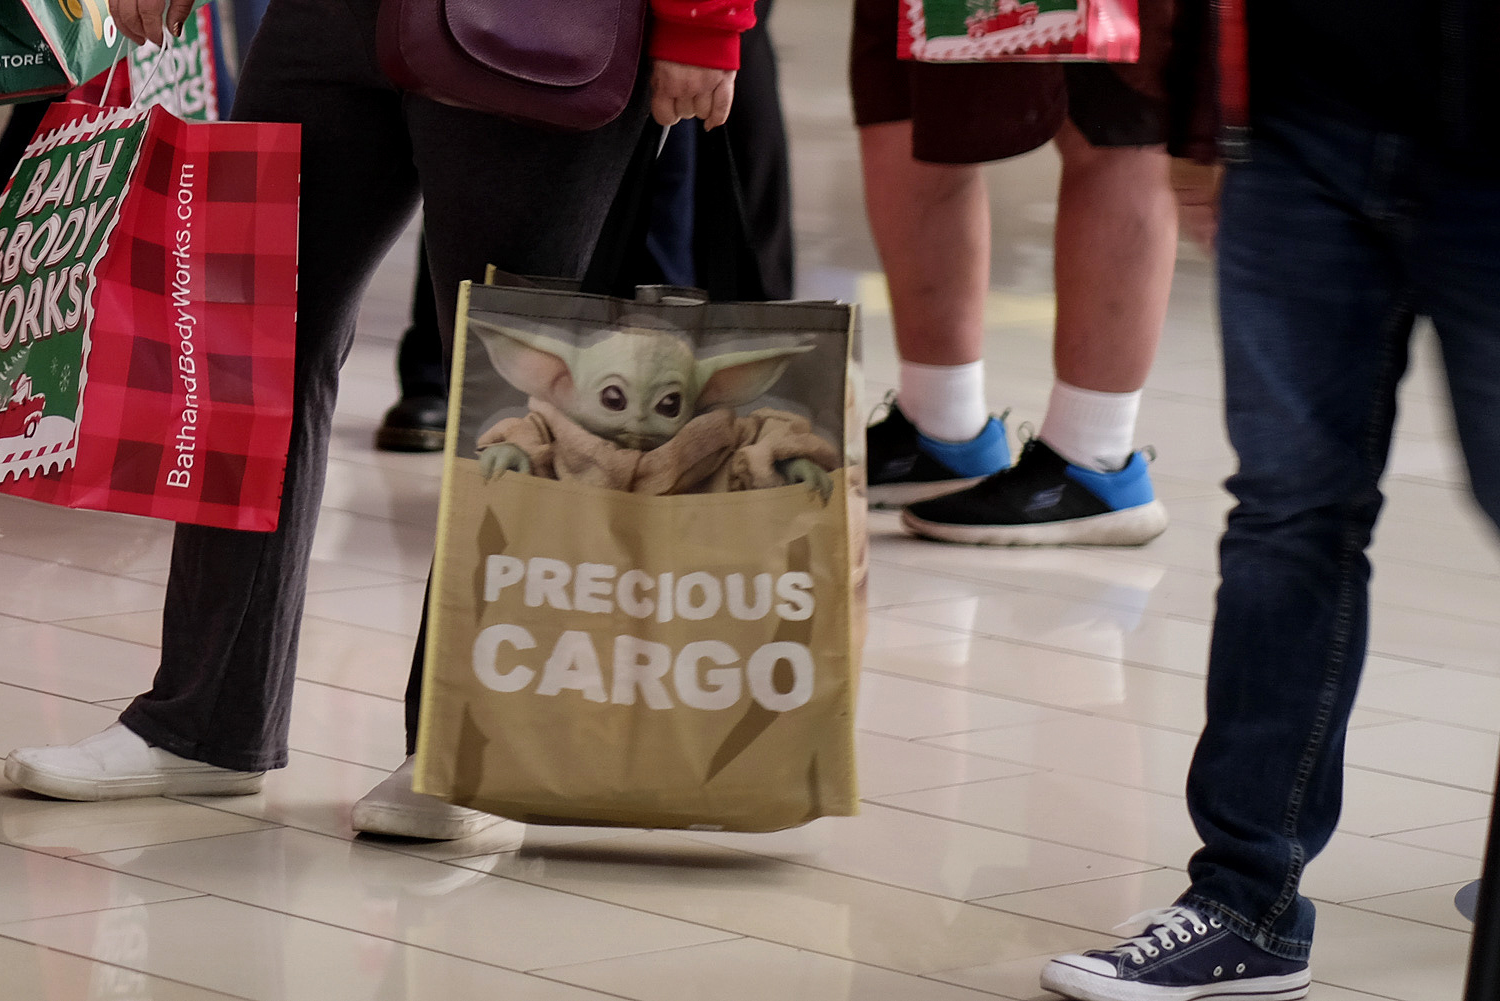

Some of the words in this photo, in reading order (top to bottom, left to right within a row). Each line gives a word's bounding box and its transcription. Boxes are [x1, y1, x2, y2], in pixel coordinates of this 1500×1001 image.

[15, 136, 126, 220] BATH
[166, 163, 196, 489] BathandBodyWorks.com
[483, 554, 816, 624] PRECIOUS
[471, 623, 816, 712] CARGO
